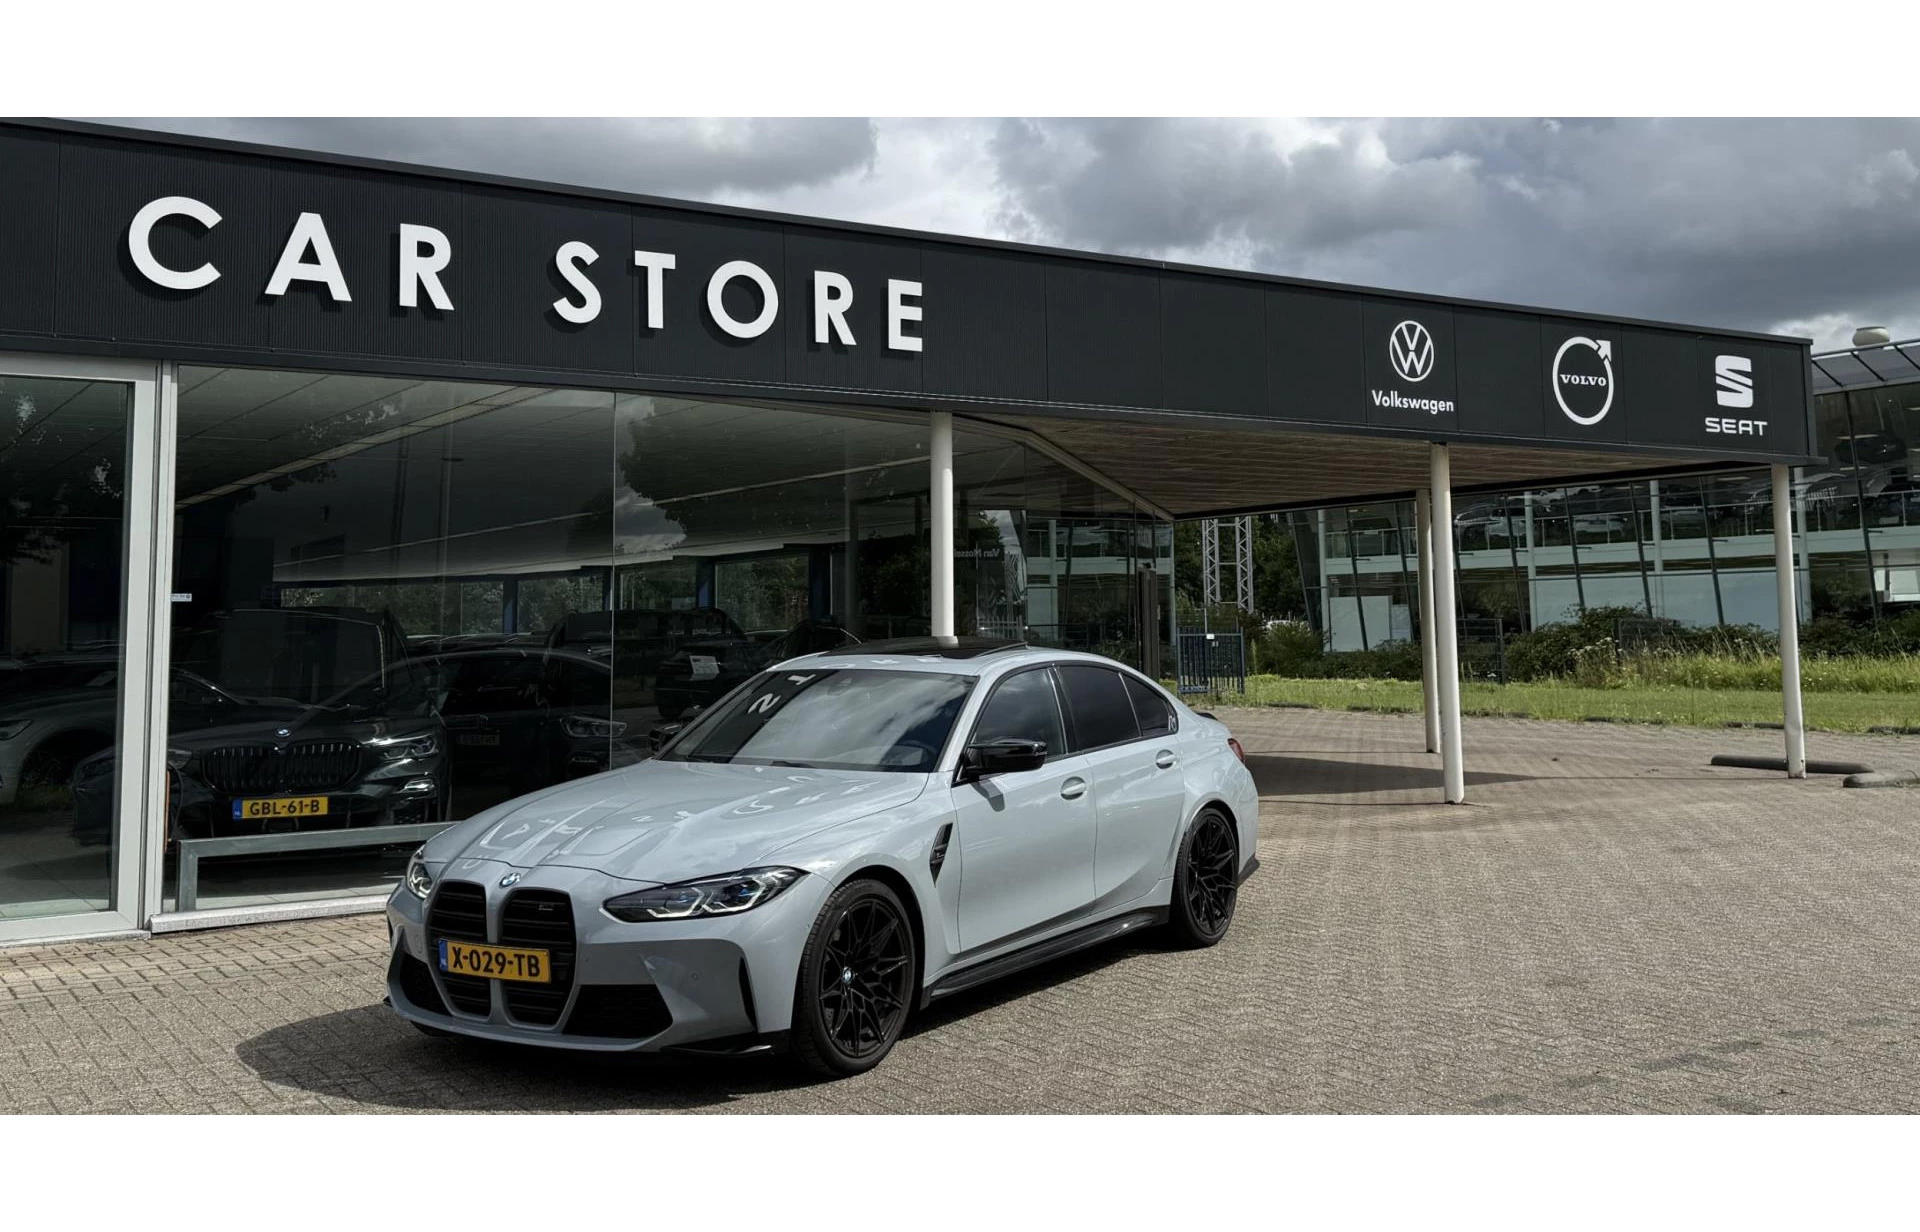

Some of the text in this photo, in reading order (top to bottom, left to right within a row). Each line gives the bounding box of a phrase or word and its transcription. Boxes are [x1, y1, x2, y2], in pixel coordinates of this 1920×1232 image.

[129, 196, 922, 352] CAR STORE
[1560, 372, 1607, 387] VOLVO
[1372, 389, 1454, 415] Volkswagen
[1705, 417, 1768, 436] SEAT
[249, 800, 320, 816] GBL-61-B
[452, 946, 540, 977] X-029-TB
